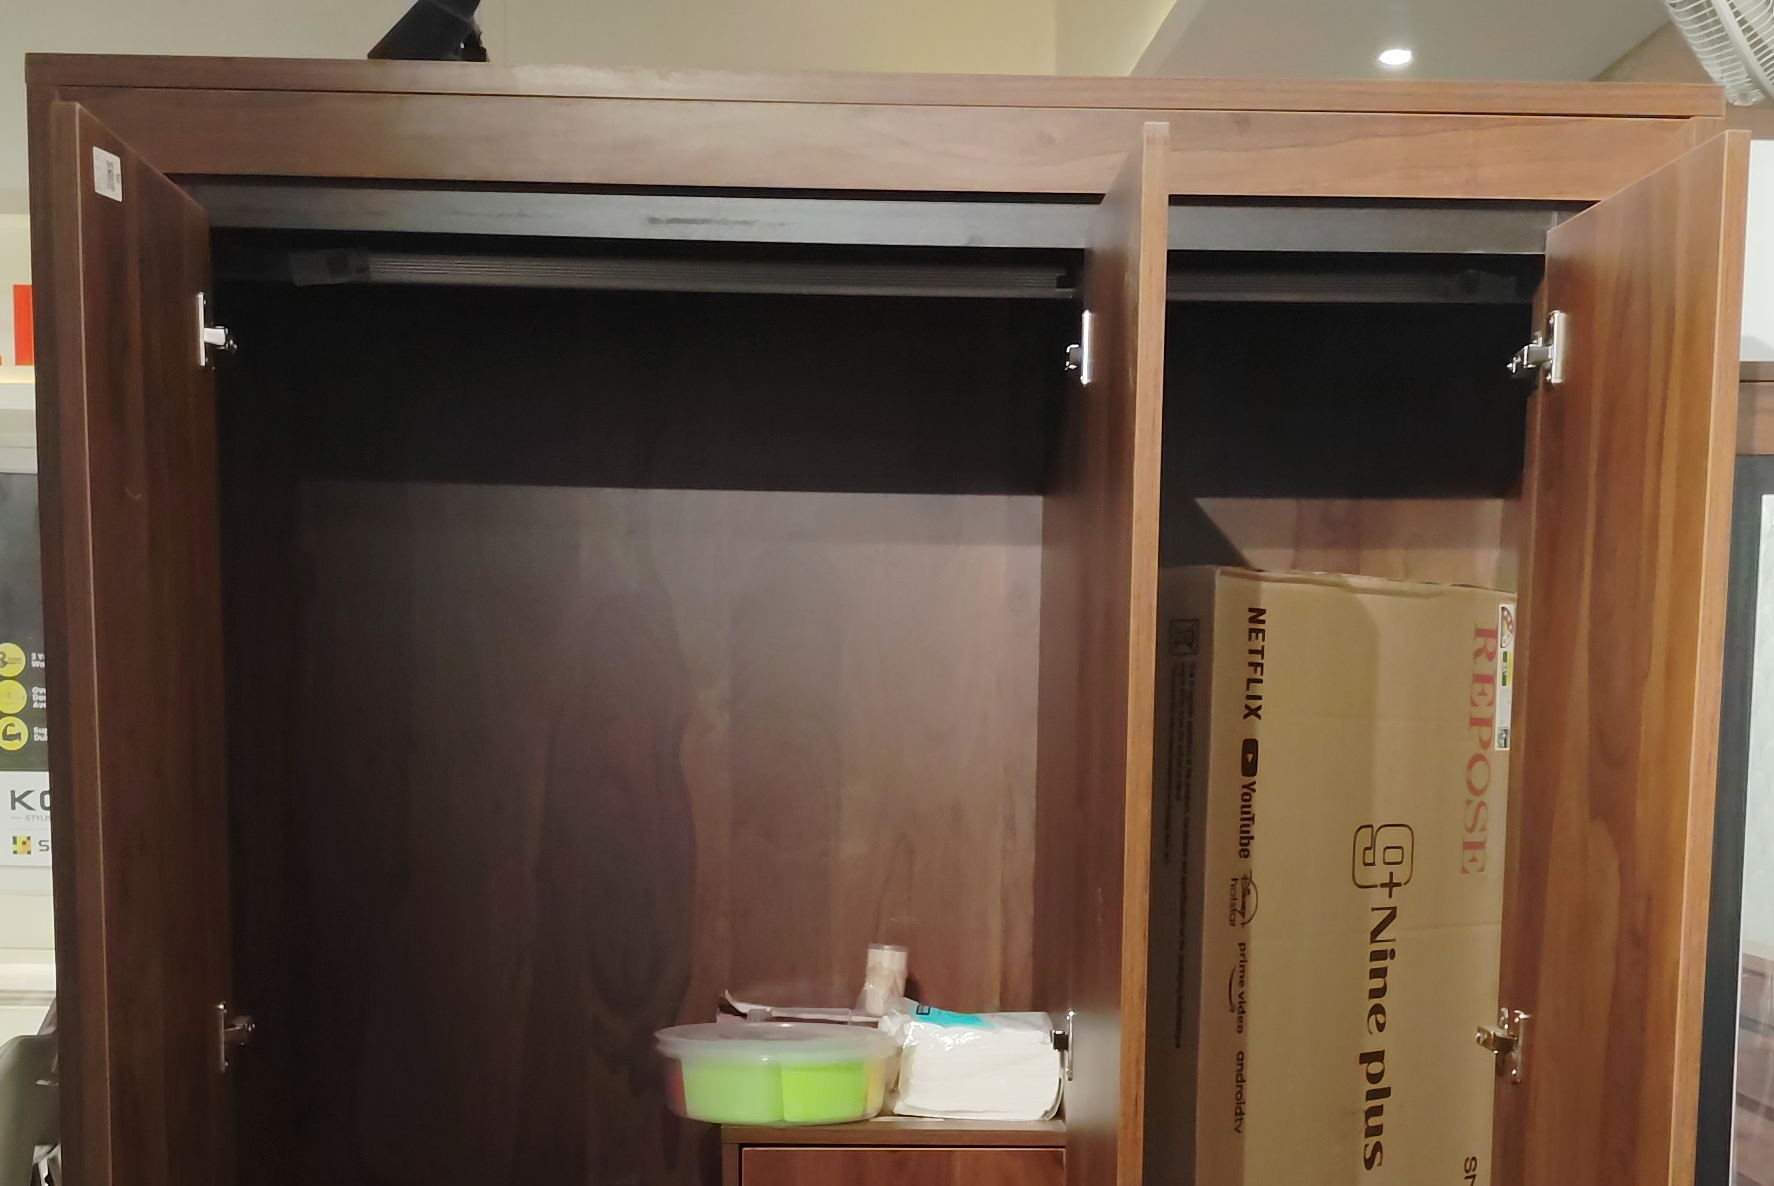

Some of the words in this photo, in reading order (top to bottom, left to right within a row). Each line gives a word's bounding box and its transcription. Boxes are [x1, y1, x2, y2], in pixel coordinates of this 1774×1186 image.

[1243, 607, 1267, 721] NETFLIX
[1461, 621, 1498, 875] REPOSE
[1238, 780, 1257, 859] YouTube
[1236, 990, 1247, 1034] video
[1237, 941, 1248, 987] prime
[1366, 905, 1398, 1036] Nine
[1358, 1049, 1392, 1171] plus
